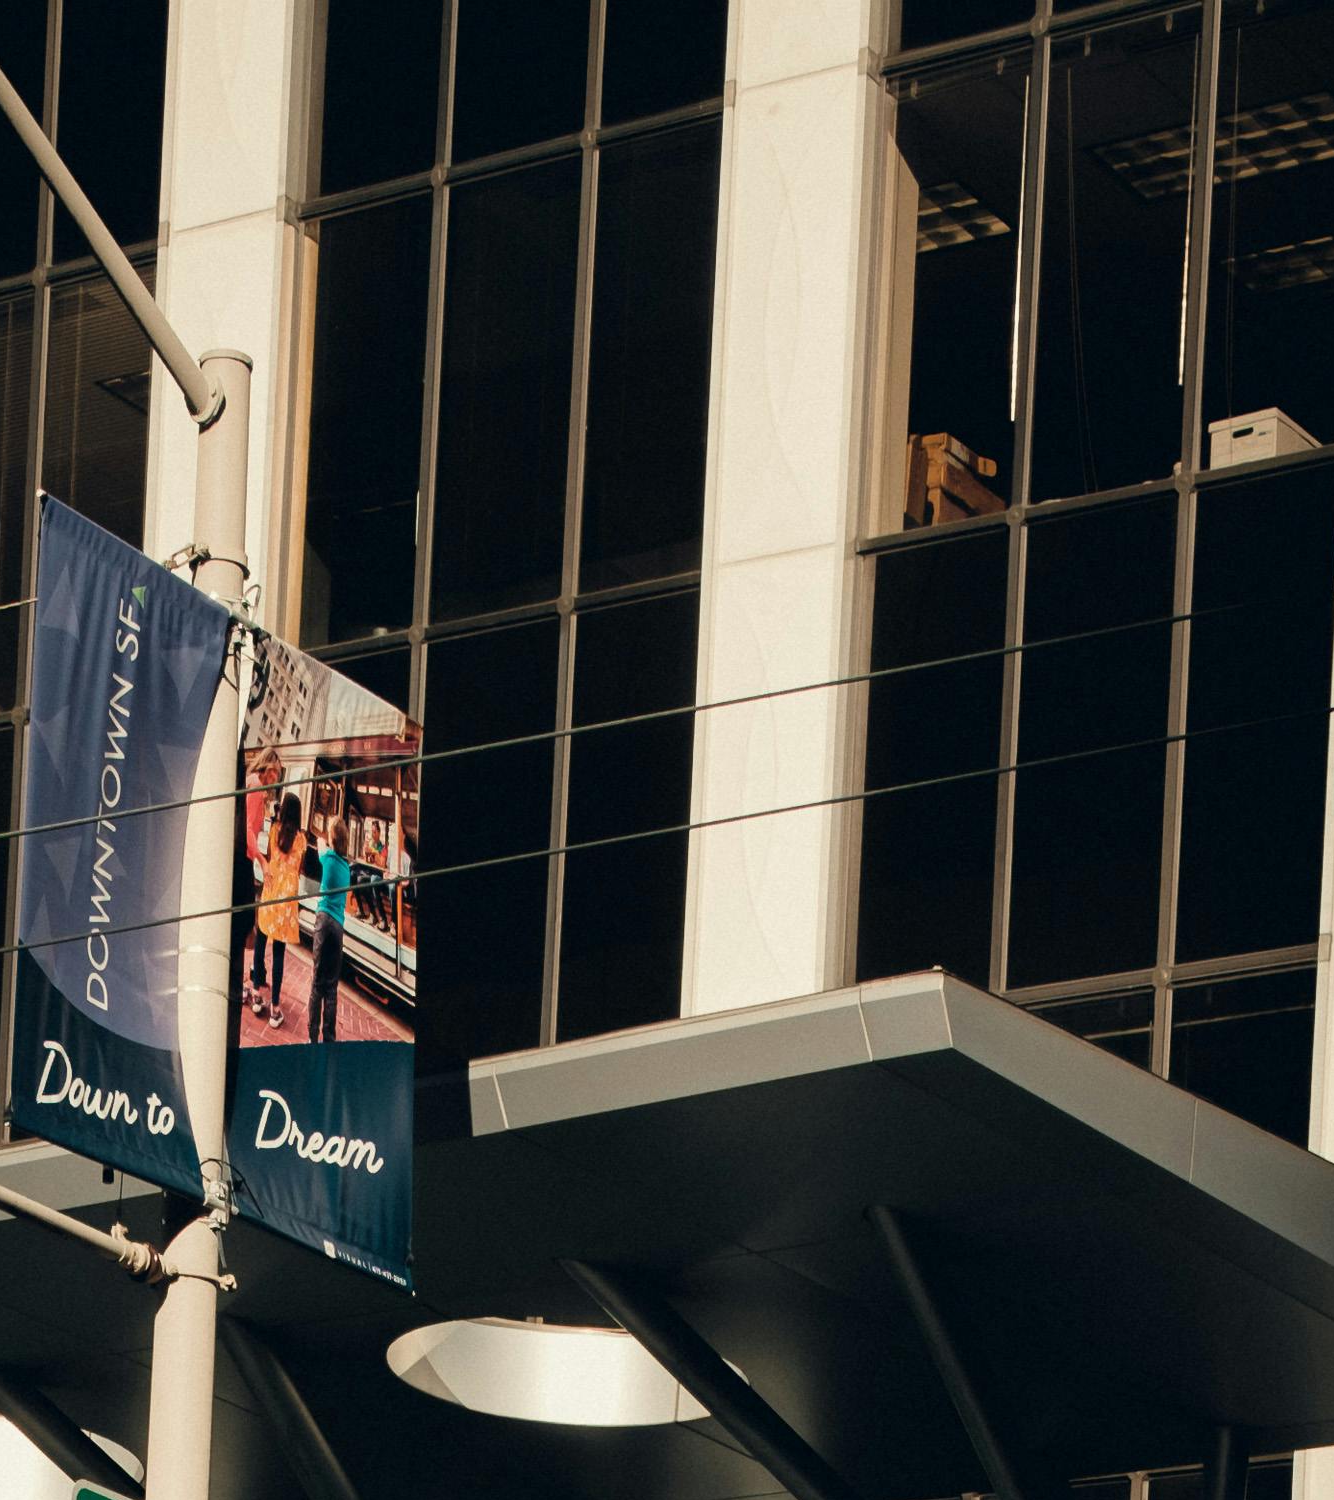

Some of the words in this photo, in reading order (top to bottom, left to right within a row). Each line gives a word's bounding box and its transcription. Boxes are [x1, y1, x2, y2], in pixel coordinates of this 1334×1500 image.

[85, 673, 134, 1012] DOWNTOWN
[115, 596, 143, 662] SF
[36, 1040, 139, 1125] Down
[146, 1092, 175, 1135] to
[255, 1089, 384, 1174] Dream
